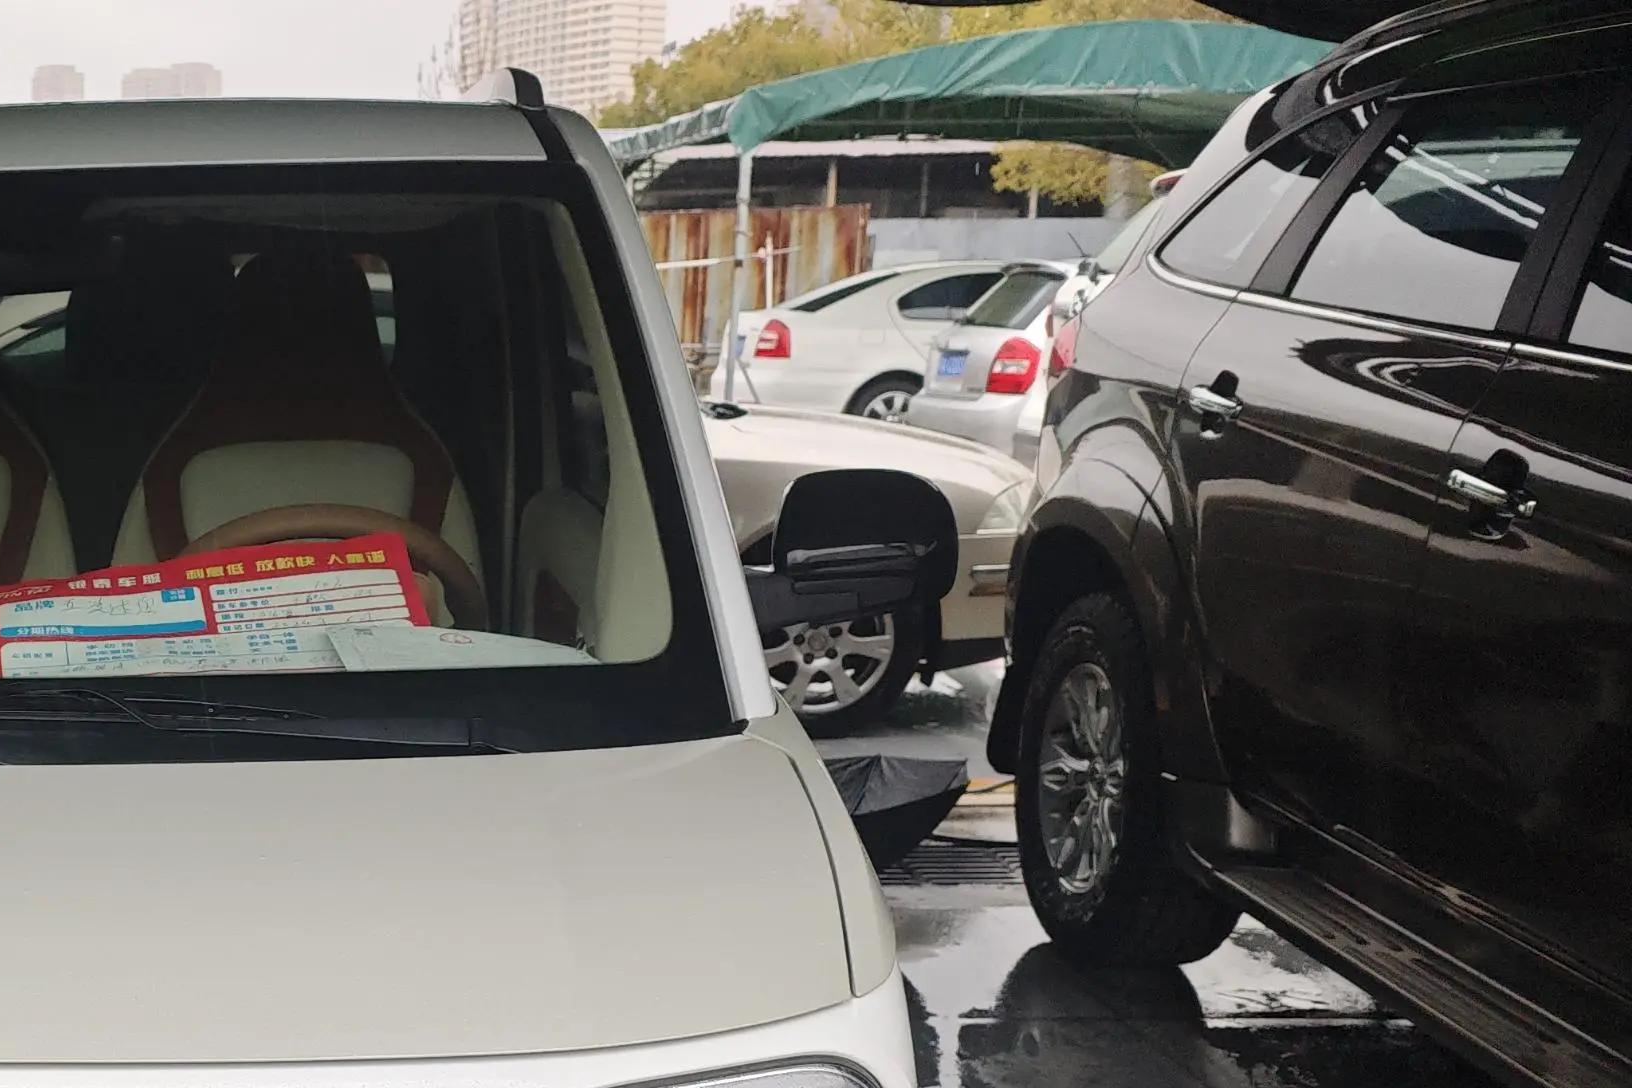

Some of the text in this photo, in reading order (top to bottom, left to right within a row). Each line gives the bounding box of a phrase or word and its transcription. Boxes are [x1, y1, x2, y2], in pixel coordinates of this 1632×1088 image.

[185, 562, 244, 580] 利息低
[327, 550, 386, 565] 人靠谱
[14, 600, 55, 613] 品牌
